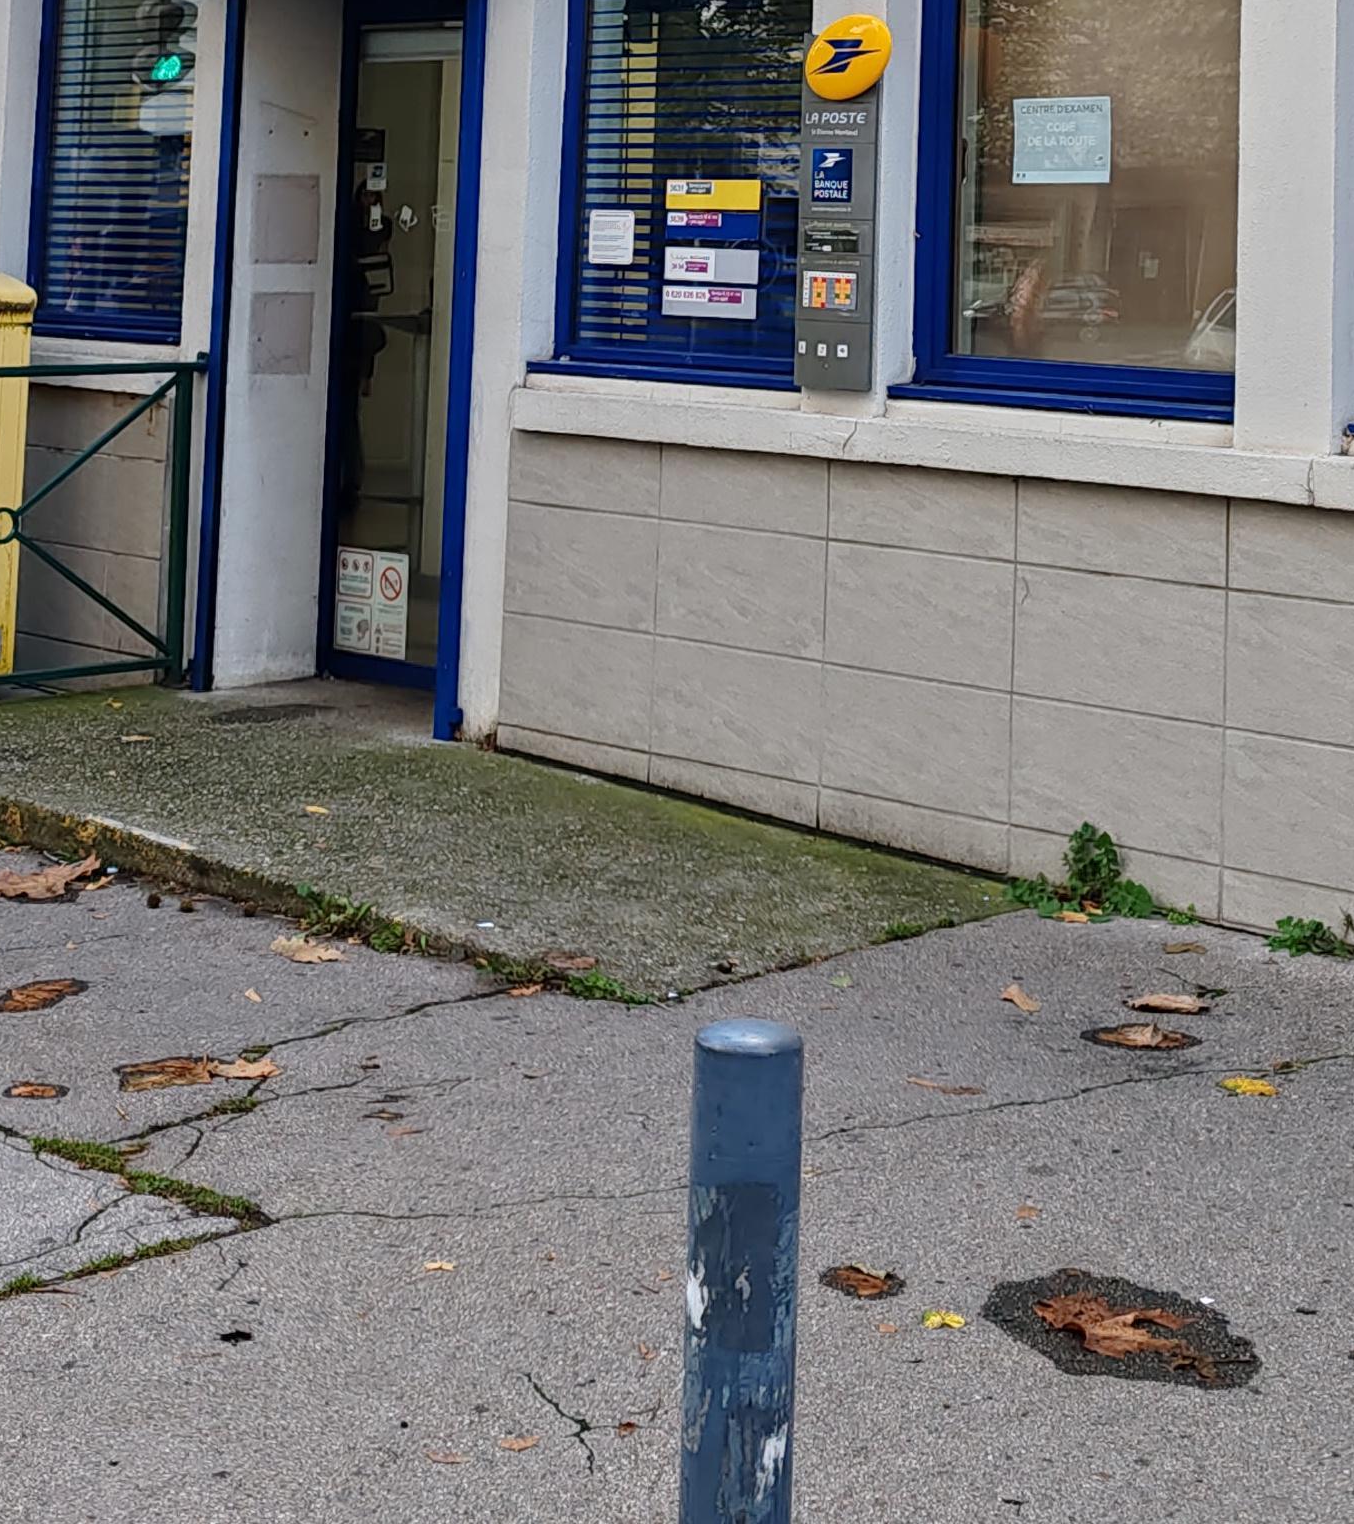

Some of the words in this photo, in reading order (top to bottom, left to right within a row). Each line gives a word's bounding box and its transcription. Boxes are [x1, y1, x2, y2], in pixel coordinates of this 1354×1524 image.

[1020, 105, 1054, 115] CENTRE
[1057, 103, 1103, 114] D'EXAMEN
[805, 112, 819, 124] LA
[821, 112, 867, 124] POSTE
[1046, 121, 1076, 132] CODE
[1027, 136, 1042, 147] DE
[1044, 136, 1058, 147] LA
[1059, 135, 1097, 146] ROUTE
[814, 170, 825, 179] LA
[814, 180, 849, 190] BANQUE
[813, 189, 848, 199] POSTALE
